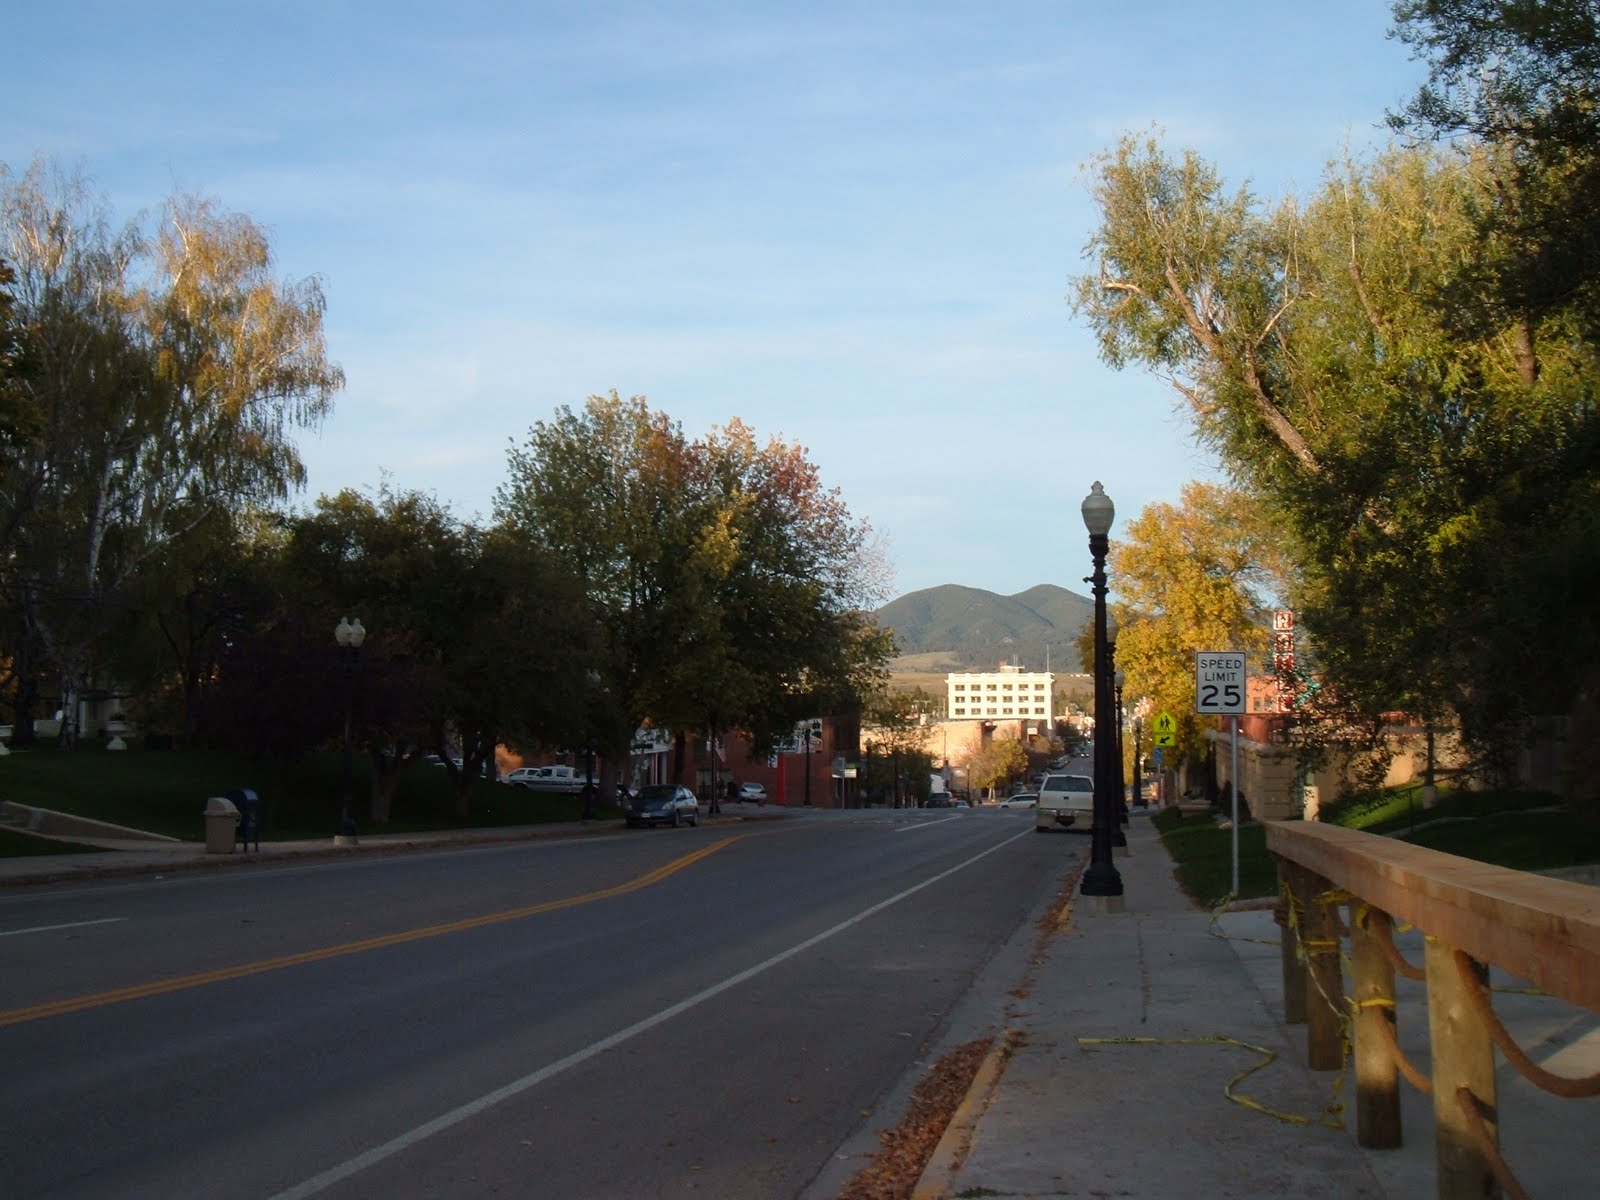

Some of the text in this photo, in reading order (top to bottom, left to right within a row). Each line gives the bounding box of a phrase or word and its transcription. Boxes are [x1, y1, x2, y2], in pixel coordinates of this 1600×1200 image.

[1200, 659, 1242, 669] SPEED
[1204, 672, 1237, 682] LIMIT
[1201, 684, 1241, 707] 25
